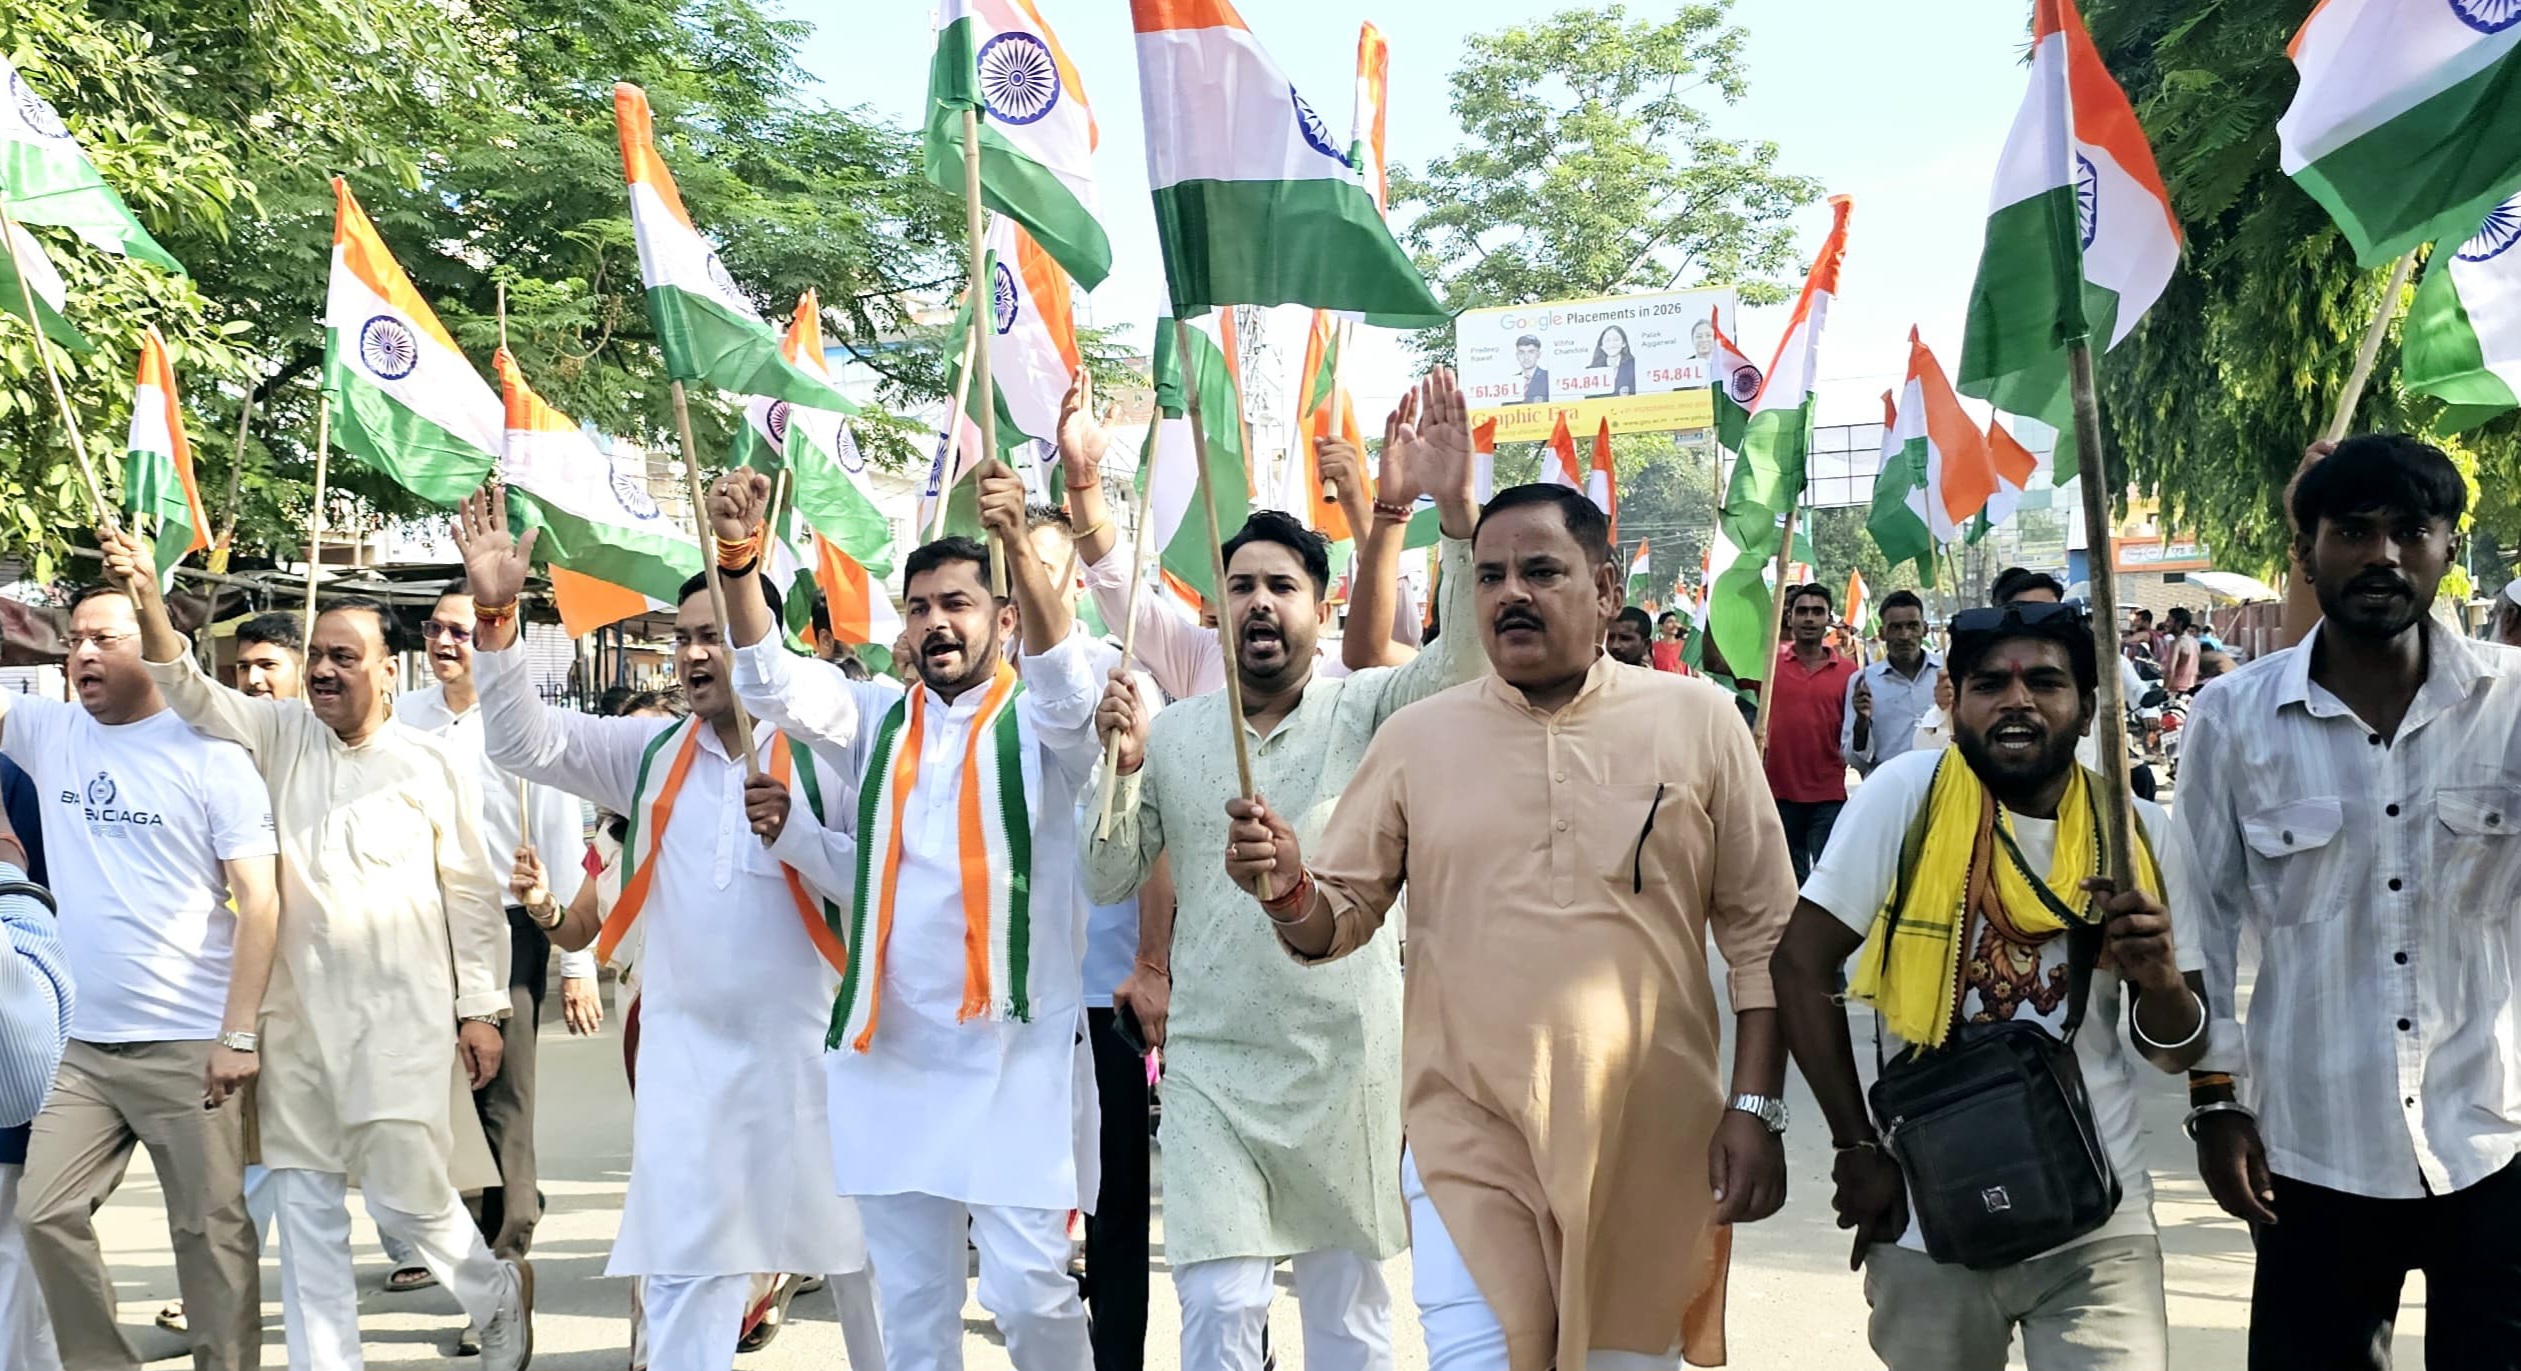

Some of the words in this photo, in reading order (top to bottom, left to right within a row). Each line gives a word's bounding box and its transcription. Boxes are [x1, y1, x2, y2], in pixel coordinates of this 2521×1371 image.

[1500, 311, 1563, 331] Google
[1567, 309, 1636, 324] Placements
[1638, 305, 1650, 317] in
[1653, 302, 1682, 316] 2026
[1695, 365, 1703, 379] L
[1602, 374, 1611, 388] L
[1513, 383, 1520, 395] L
[1471, 408, 1541, 429] Gaphic
